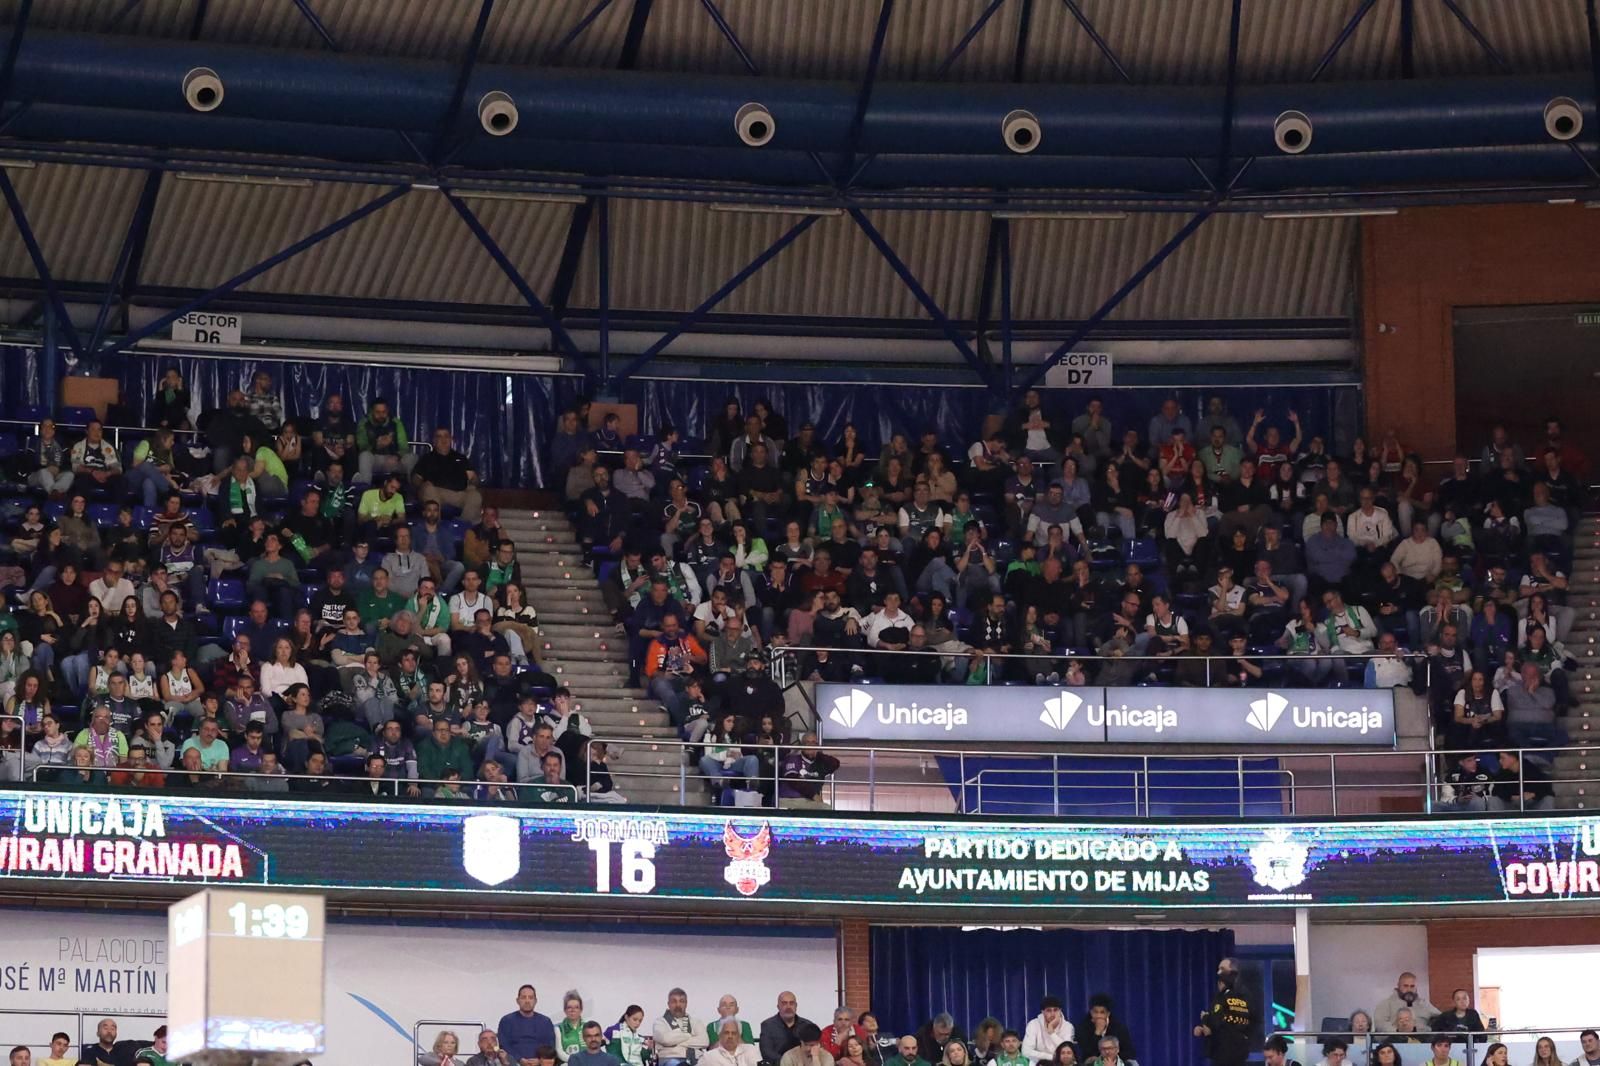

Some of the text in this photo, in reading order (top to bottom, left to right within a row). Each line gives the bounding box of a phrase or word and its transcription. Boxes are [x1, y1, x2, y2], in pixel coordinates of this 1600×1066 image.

[178, 313, 238, 329] SECTOR
[195, 329, 221, 344] D6
[1067, 369, 1094, 385] D7
[877, 702, 968, 731] Unicaja
[1087, 704, 1178, 733] Unicaja
[1292, 706, 1383, 734] Unicaja
[24, 797, 167, 838] UNICAJA
[571, 818, 670, 845] JORNADA
[93, 839, 244, 878] GRANADA
[924, 837, 1182, 862] PARTIDO DEDICADO A
[588, 839, 656, 894] 16
[1094, 869, 1127, 891] DE
[1132, 870, 1210, 892] MIJAS
[1505, 860, 1600, 895] COVIR
[228, 901, 309, 938] 1:39
[58, 936, 166, 965] PALACIO DE
[0, 962, 30, 991] SÉ
[75, 965, 157, 995] MARTÍN
